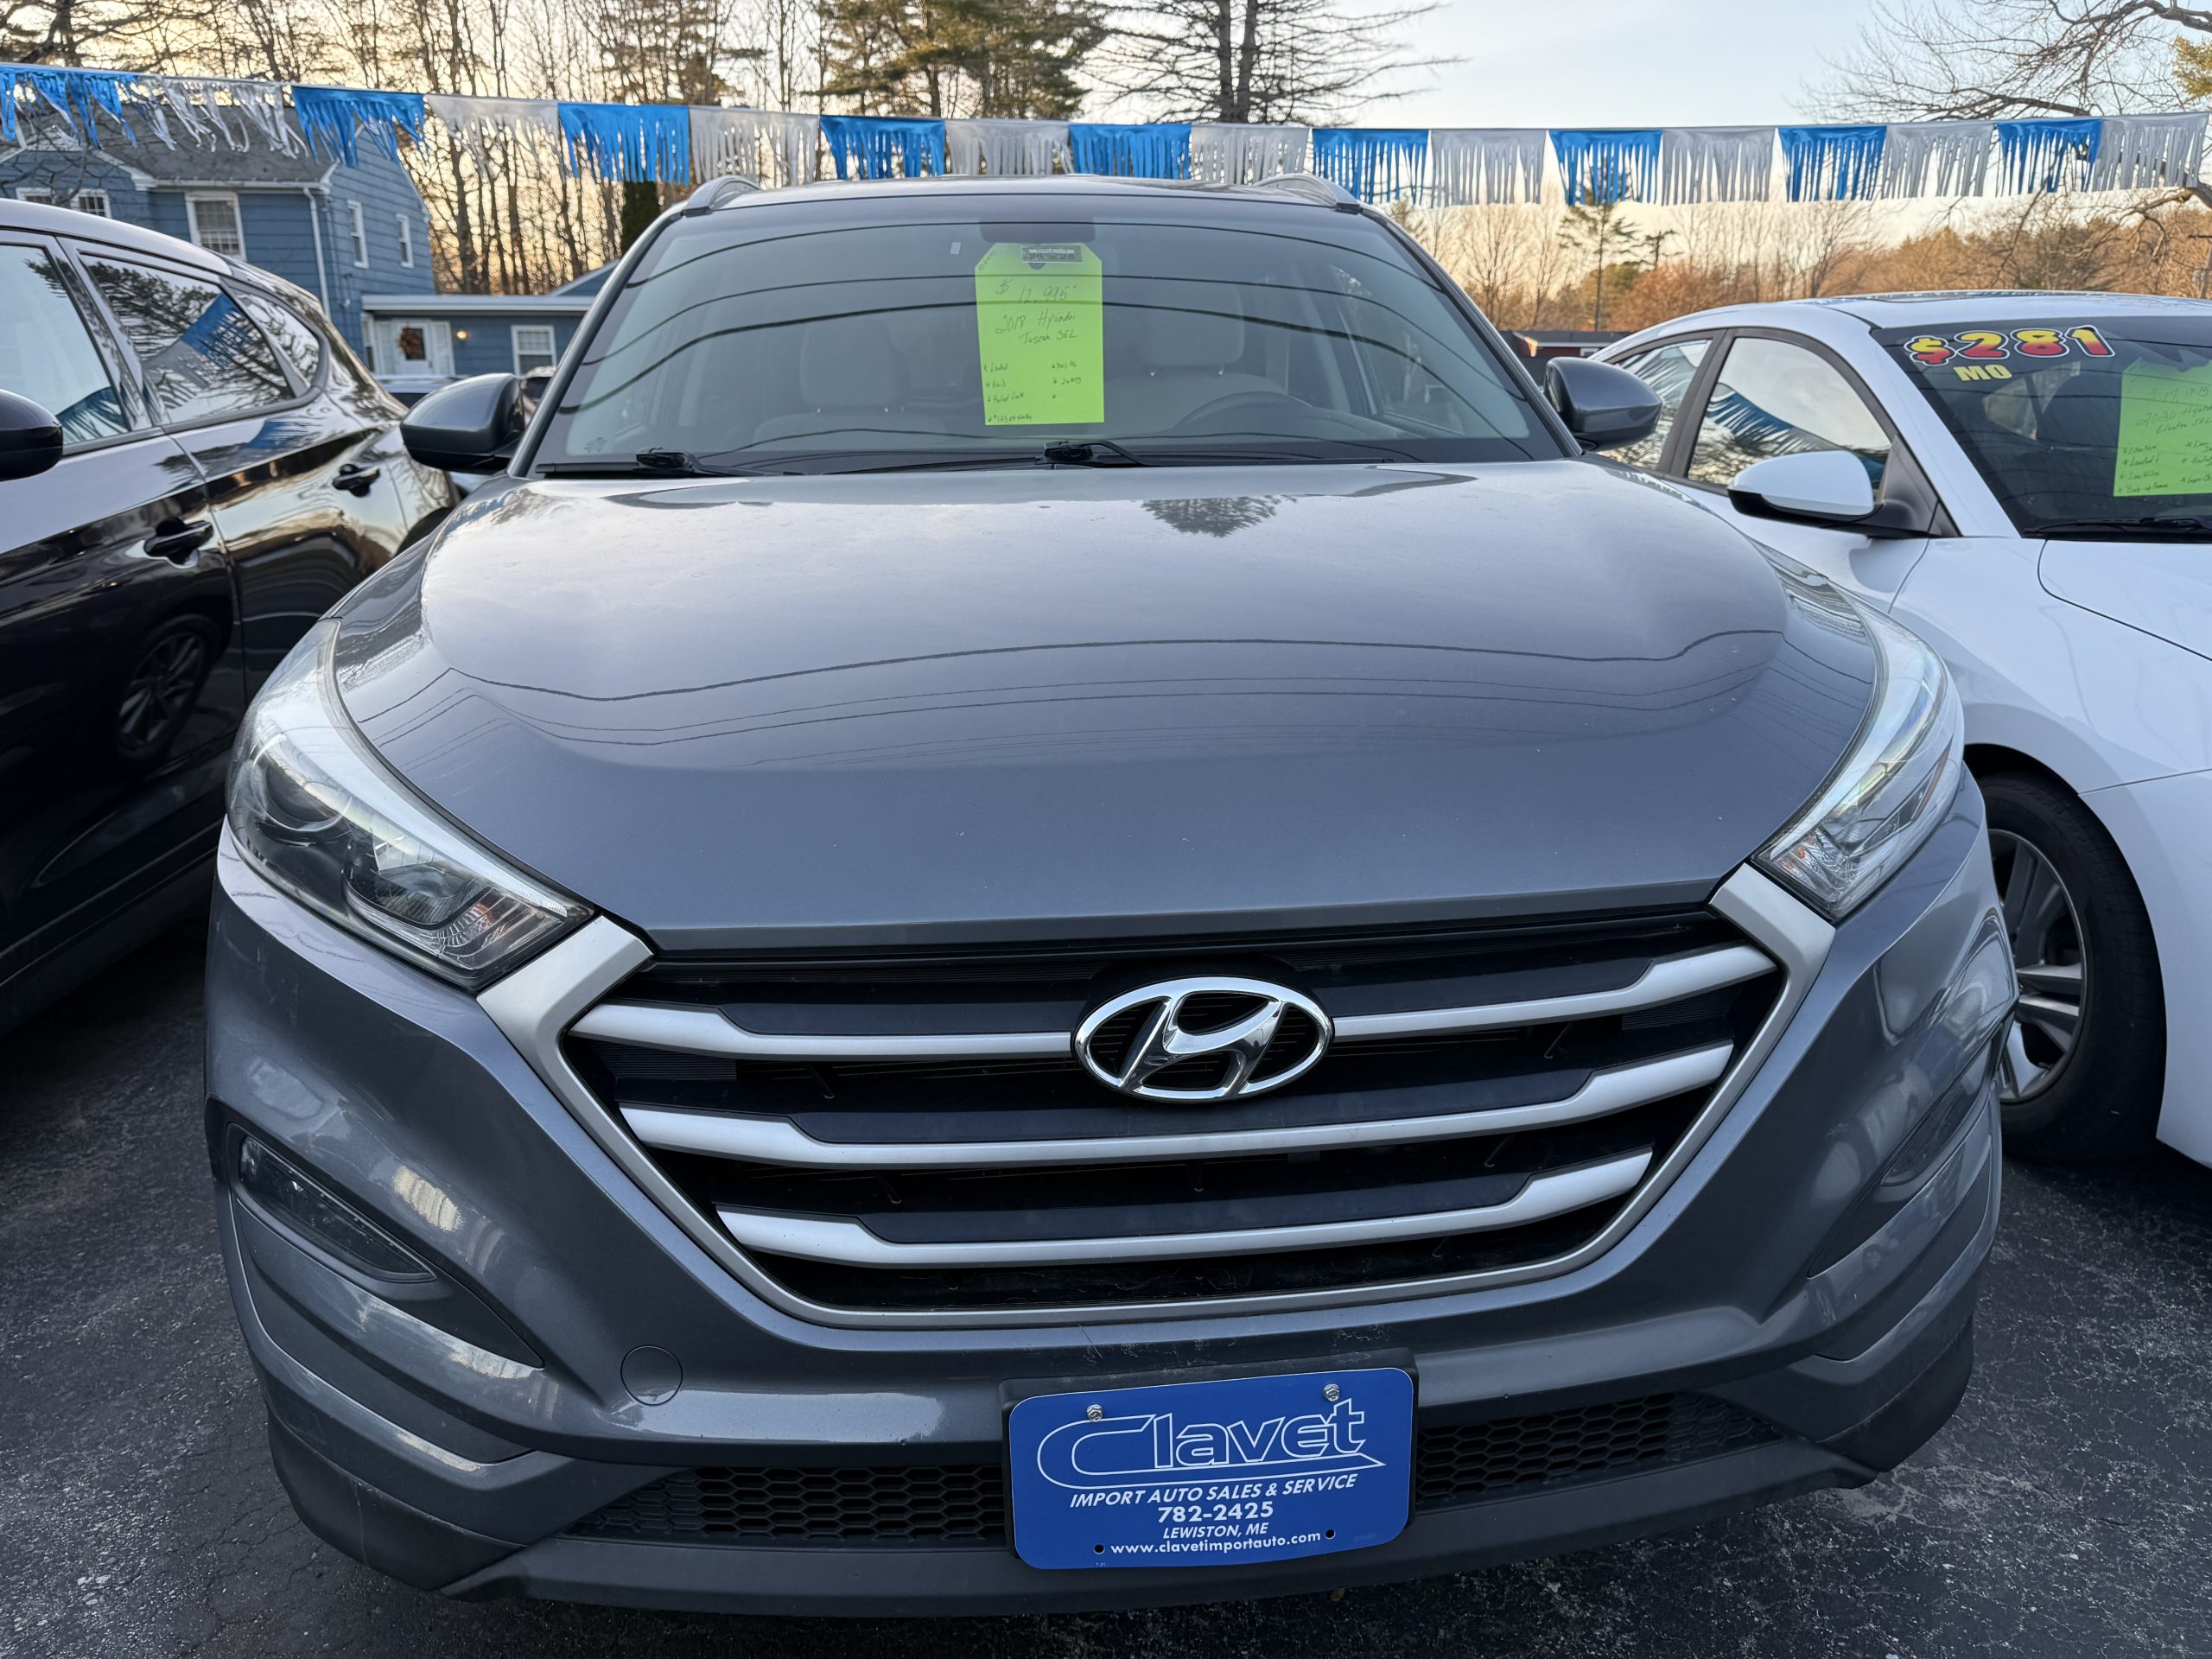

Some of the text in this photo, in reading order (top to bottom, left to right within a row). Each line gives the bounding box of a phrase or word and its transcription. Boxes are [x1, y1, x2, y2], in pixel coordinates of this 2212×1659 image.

[995, 315, 1027, 334] 2018
[1056, 328, 1077, 340] SEL
[1904, 325, 2115, 366] $281
[1953, 364, 2012, 382] MO
[1037, 1397, 1387, 1490] Clavet
[1070, 1473, 1358, 1508] IMPORT AUTO SALES & SERVICE
[1158, 1501, 1274, 1523] 782-2425
[1162, 1522, 1269, 1540] LEWISTON, ME
[1110, 1532, 1321, 1554] www.clavetimportauto.com
